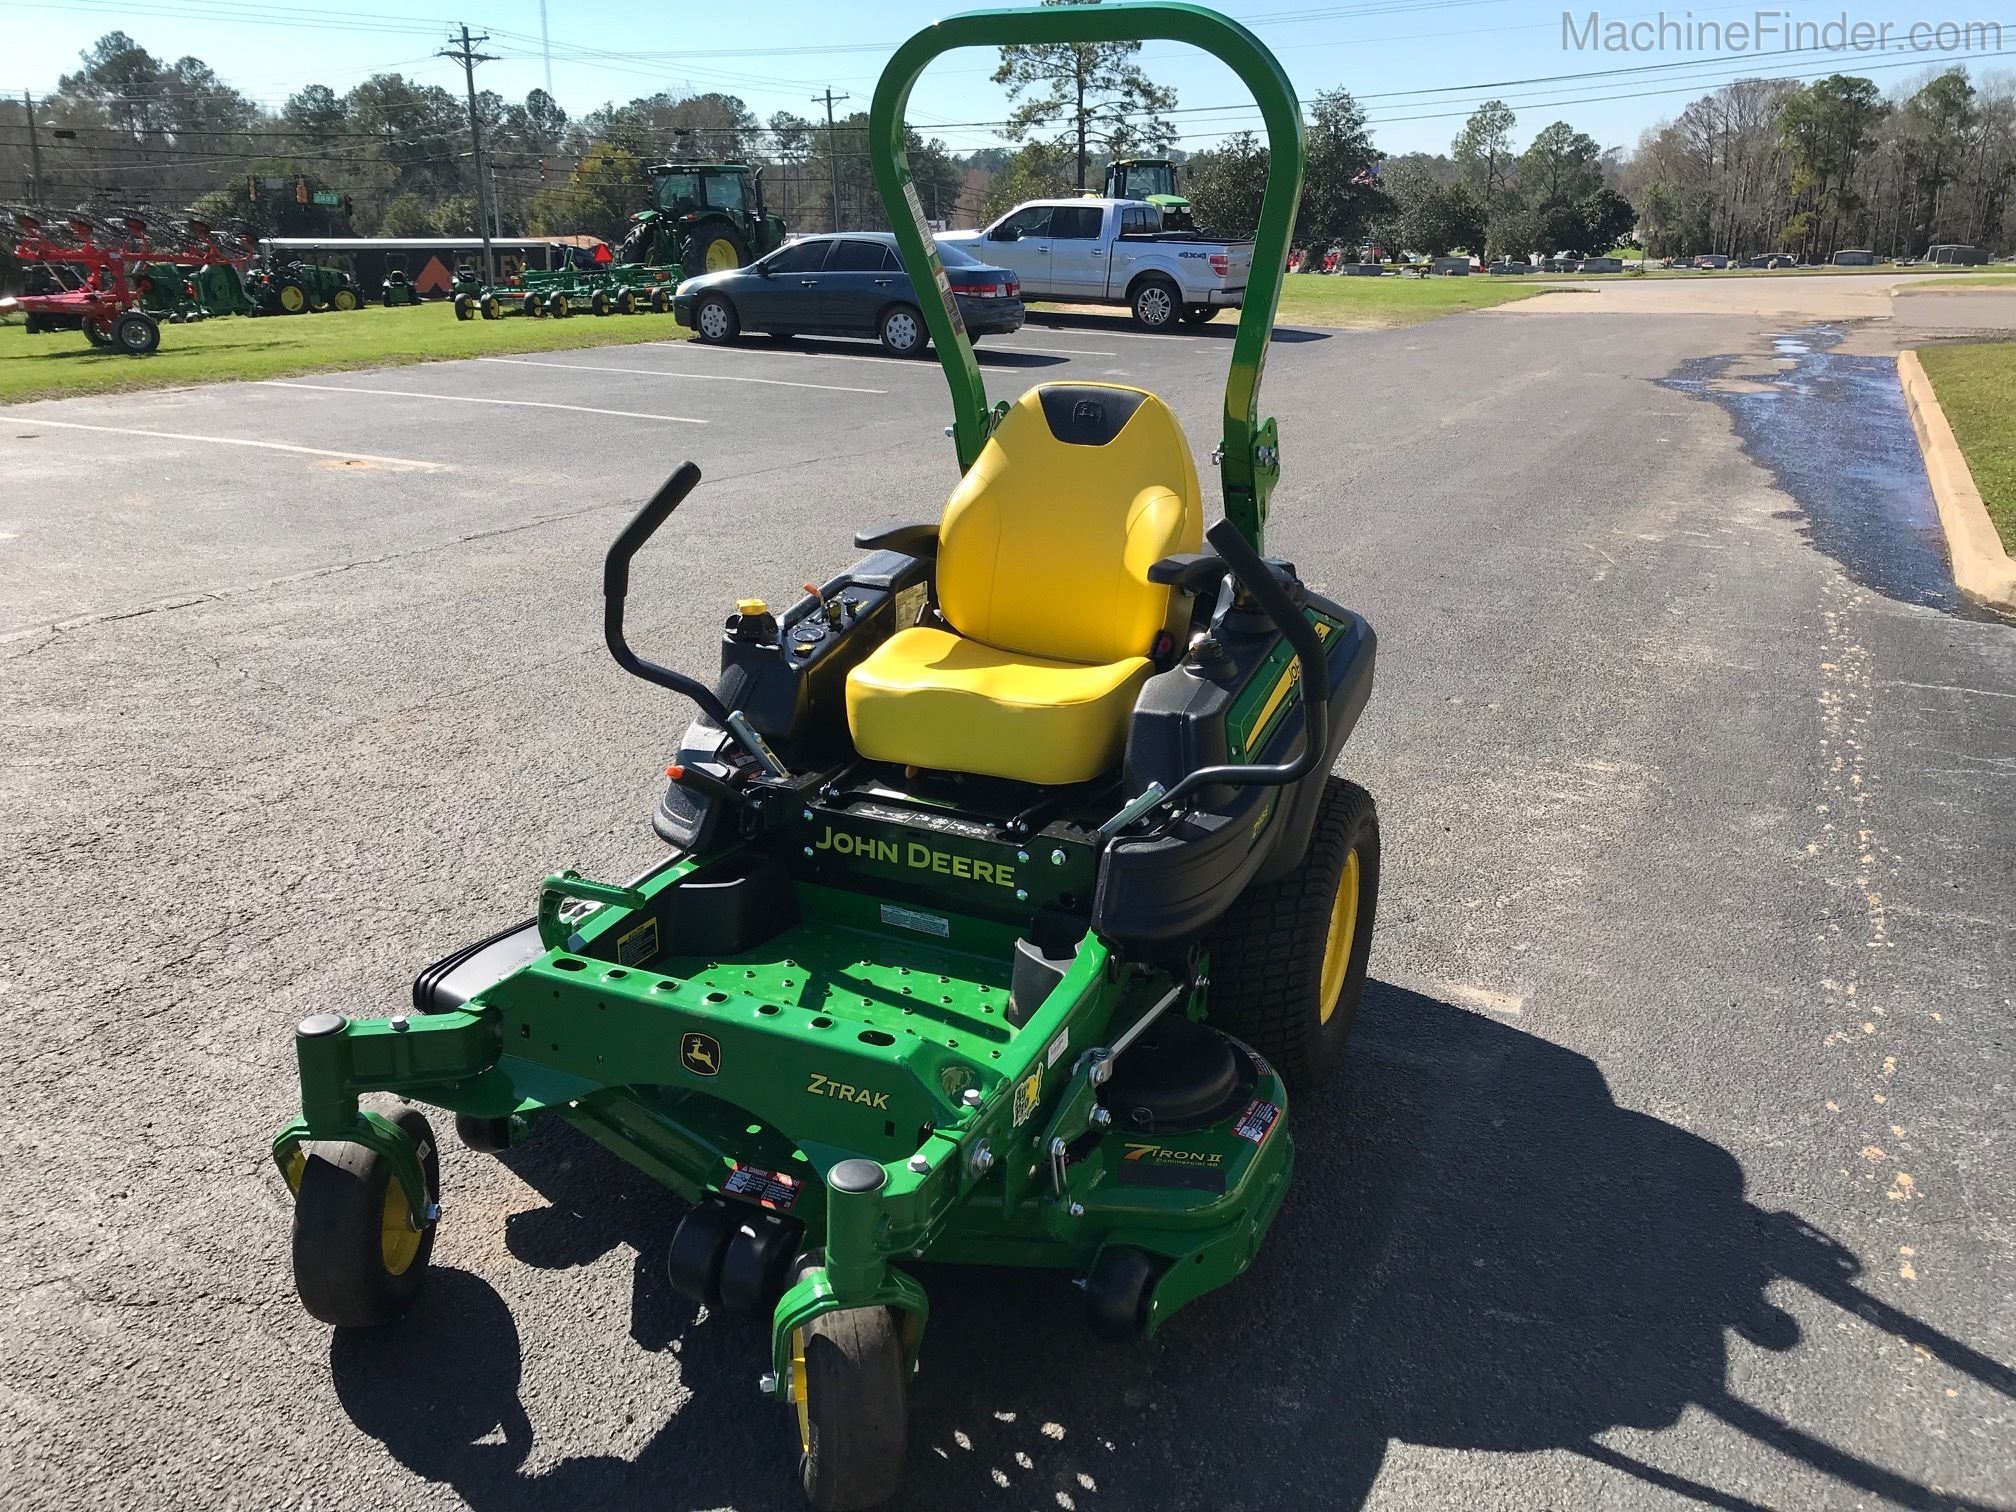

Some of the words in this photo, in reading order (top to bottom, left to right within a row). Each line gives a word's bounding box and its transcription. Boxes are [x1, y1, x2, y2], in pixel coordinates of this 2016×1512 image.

[815, 826, 898, 864] JOHN
[907, 842, 1015, 887] DEERE
[806, 1073, 891, 1110] ZTRAK
[748, 1166, 768, 1177] DANGER
